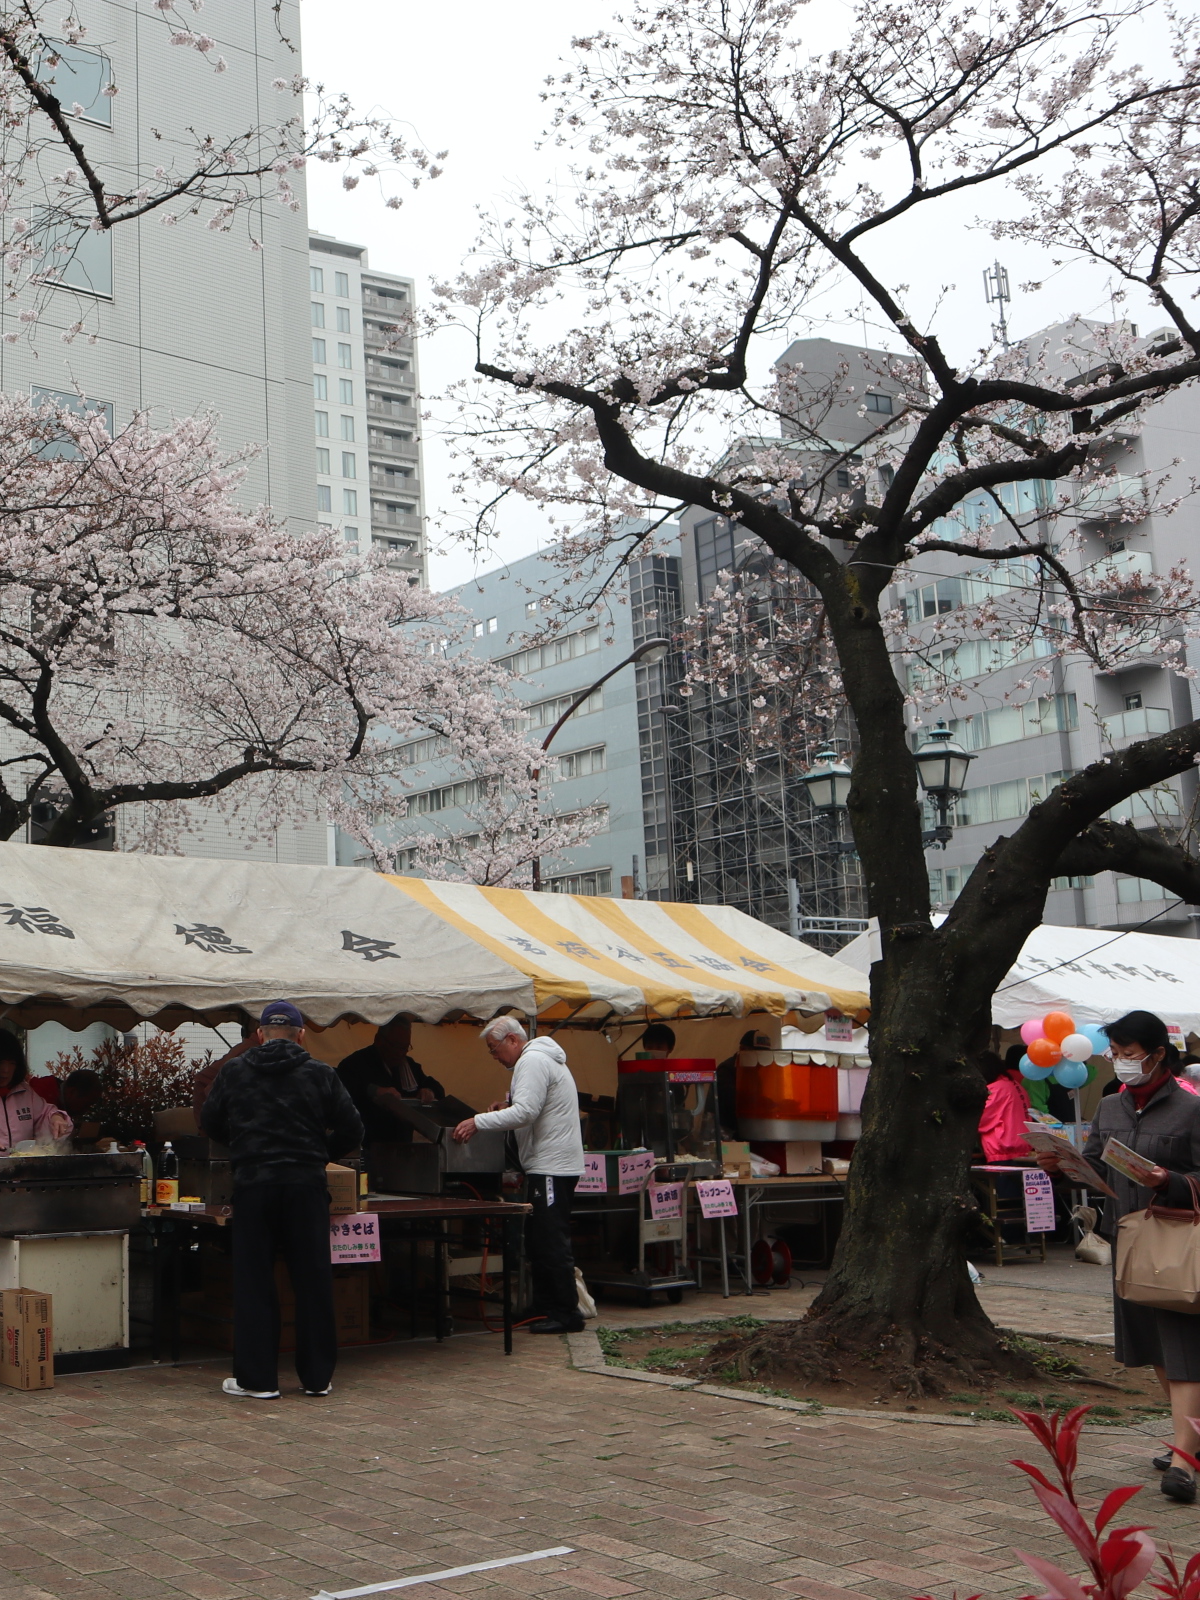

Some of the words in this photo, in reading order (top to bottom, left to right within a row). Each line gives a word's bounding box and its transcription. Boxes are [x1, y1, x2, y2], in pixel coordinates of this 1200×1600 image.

[584, 1161, 599, 1171] ール
[621, 1159, 652, 1174] ジュース
[330, 1222, 375, 1236] やきそば
